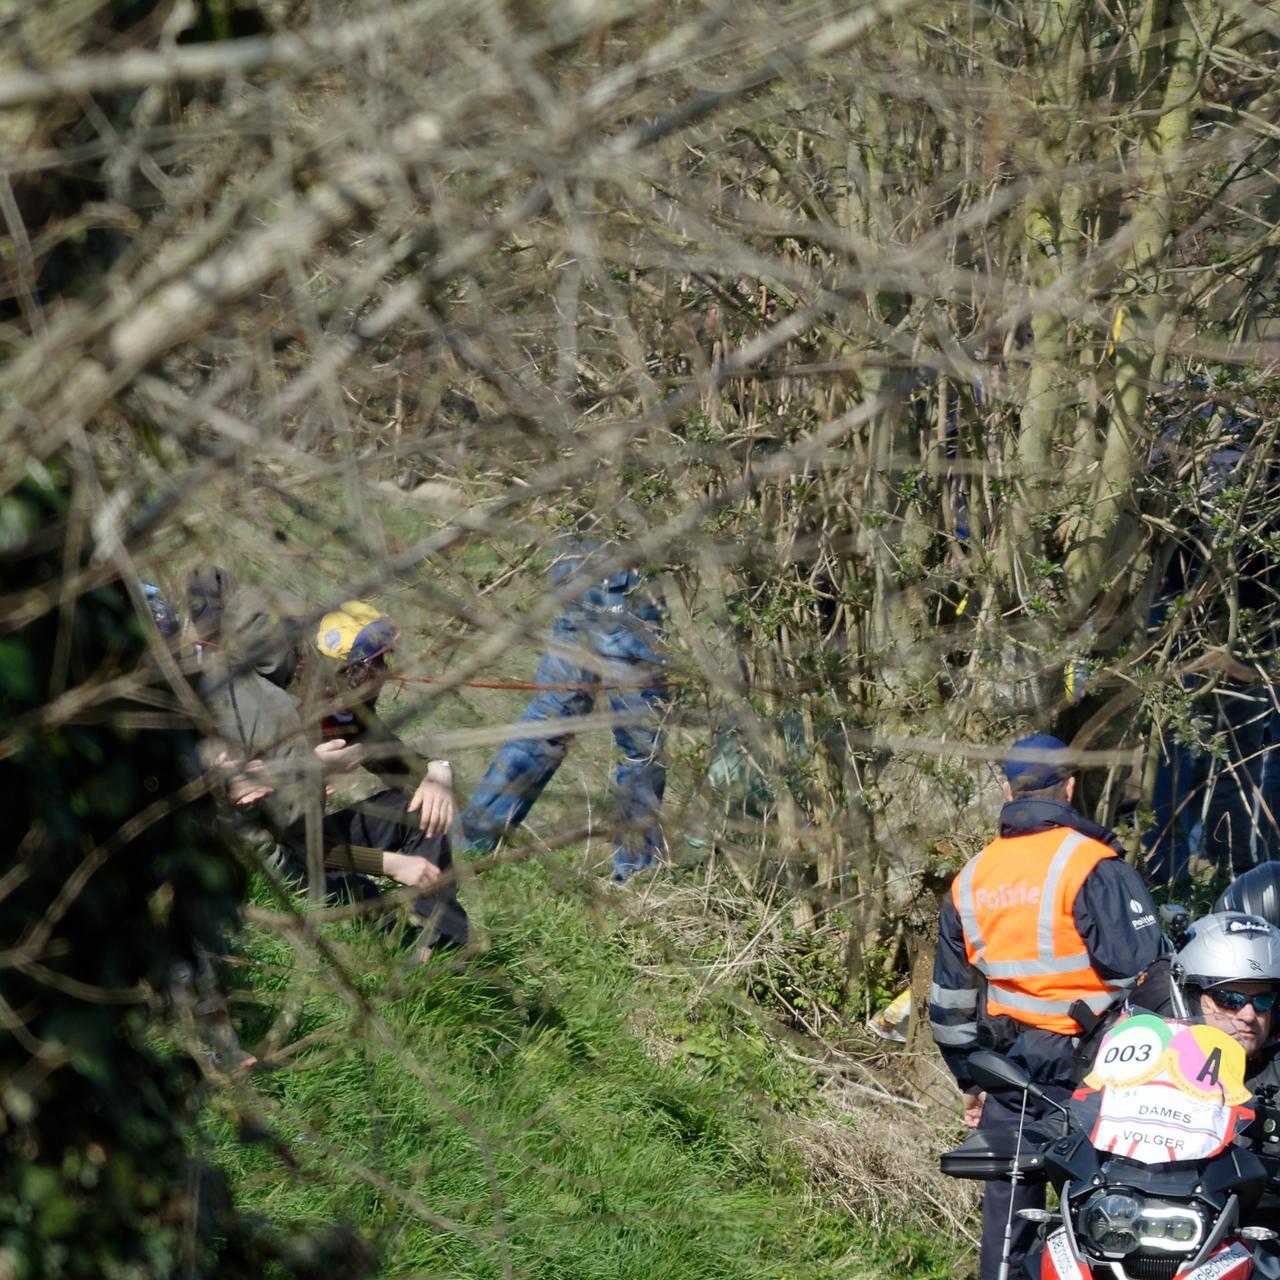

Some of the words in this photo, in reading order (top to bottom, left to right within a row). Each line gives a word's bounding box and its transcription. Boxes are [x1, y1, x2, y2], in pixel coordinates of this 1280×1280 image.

[975, 881, 1041, 912] Politie
[1196, 1047, 1222, 1086] A
[1138, 1105, 1192, 1124] DAMES
[1123, 1130, 1185, 1150] VOLGER
